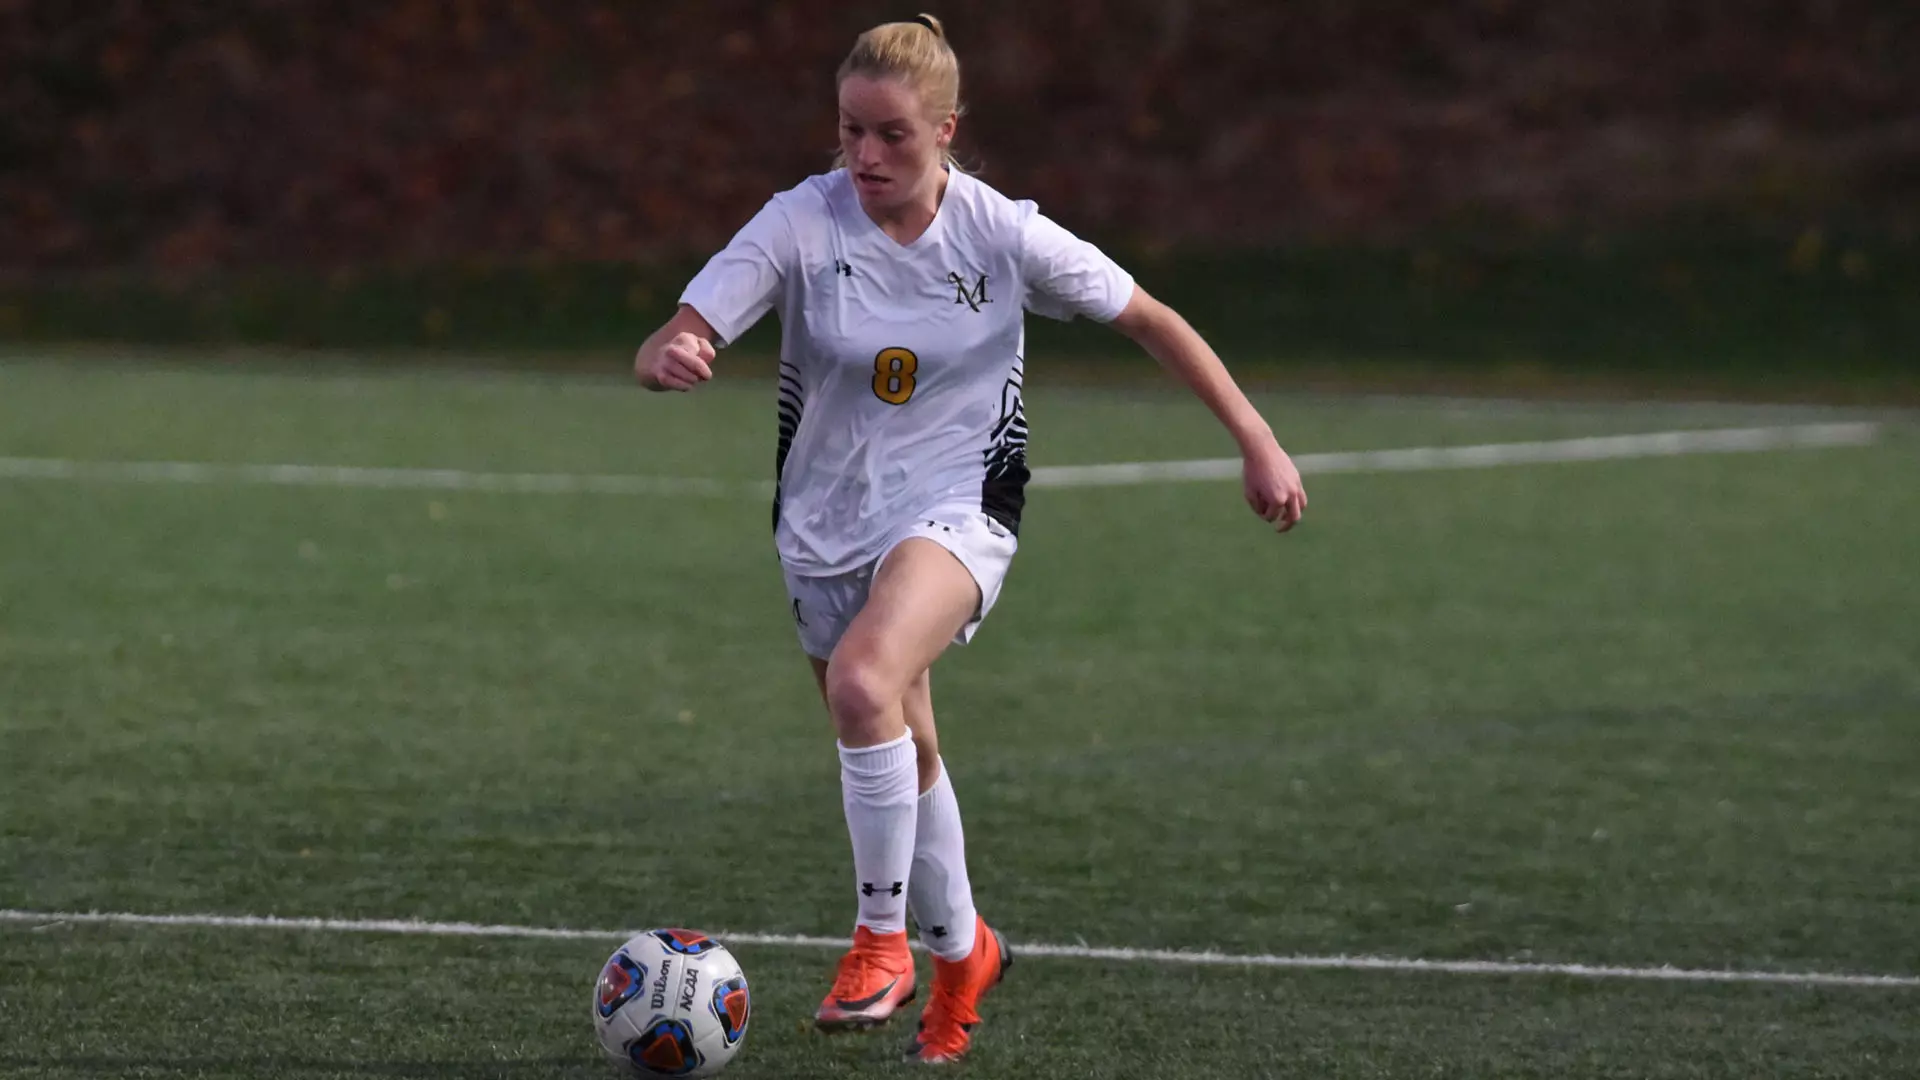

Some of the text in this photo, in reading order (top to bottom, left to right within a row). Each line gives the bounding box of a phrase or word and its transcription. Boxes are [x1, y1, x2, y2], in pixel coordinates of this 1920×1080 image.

[871, 346, 918, 405] 8
[650, 959, 672, 1010] Wilson
[679, 968, 699, 1012] NCAA
